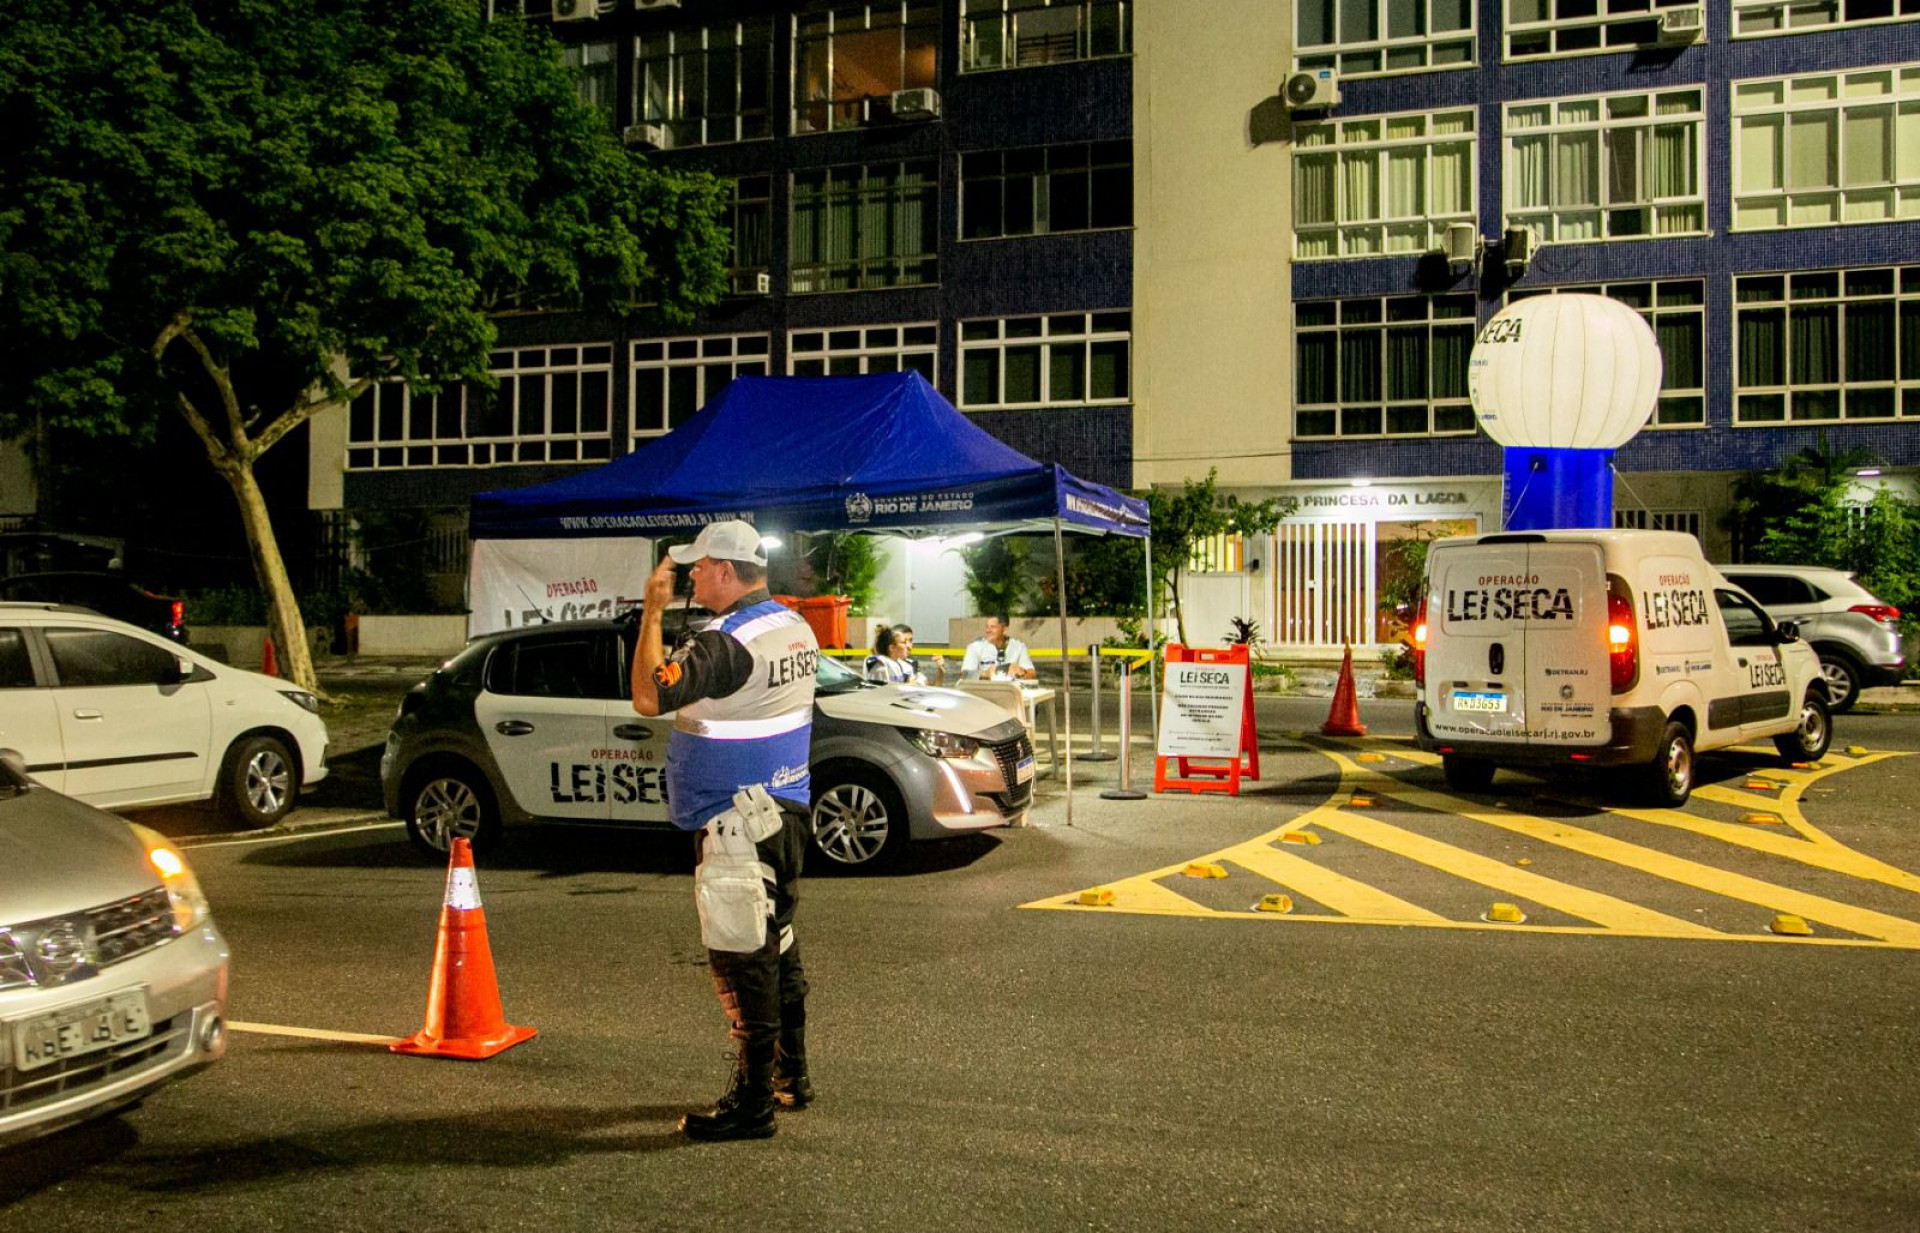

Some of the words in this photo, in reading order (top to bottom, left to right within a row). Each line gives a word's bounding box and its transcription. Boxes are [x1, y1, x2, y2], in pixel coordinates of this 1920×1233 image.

[874, 503, 898, 514] RIO
[900, 502, 917, 513] DE
[919, 499, 974, 512] JANEIRO
[1303, 494, 1379, 507] PRINCESA
[1388, 493, 1408, 505] DA
[1415, 492, 1468, 504] LAGOA
[546, 577, 598, 598] OPERAÇÃO
[1478, 574, 1540, 587] OPERAÇÃO
[1447, 589, 1489, 621] LEI
[1493, 588, 1574, 621] SECA
[1643, 588, 1670, 631] LEI
[1671, 589, 1710, 628] SECA
[767, 655, 795, 689] LEI
[796, 649, 819, 679] SEC
[1180, 671, 1198, 684] LEI
[1200, 672, 1230, 685] SECA
[591, 747, 653, 763] OPERAÇÃO
[550, 762, 606, 803] LEI
